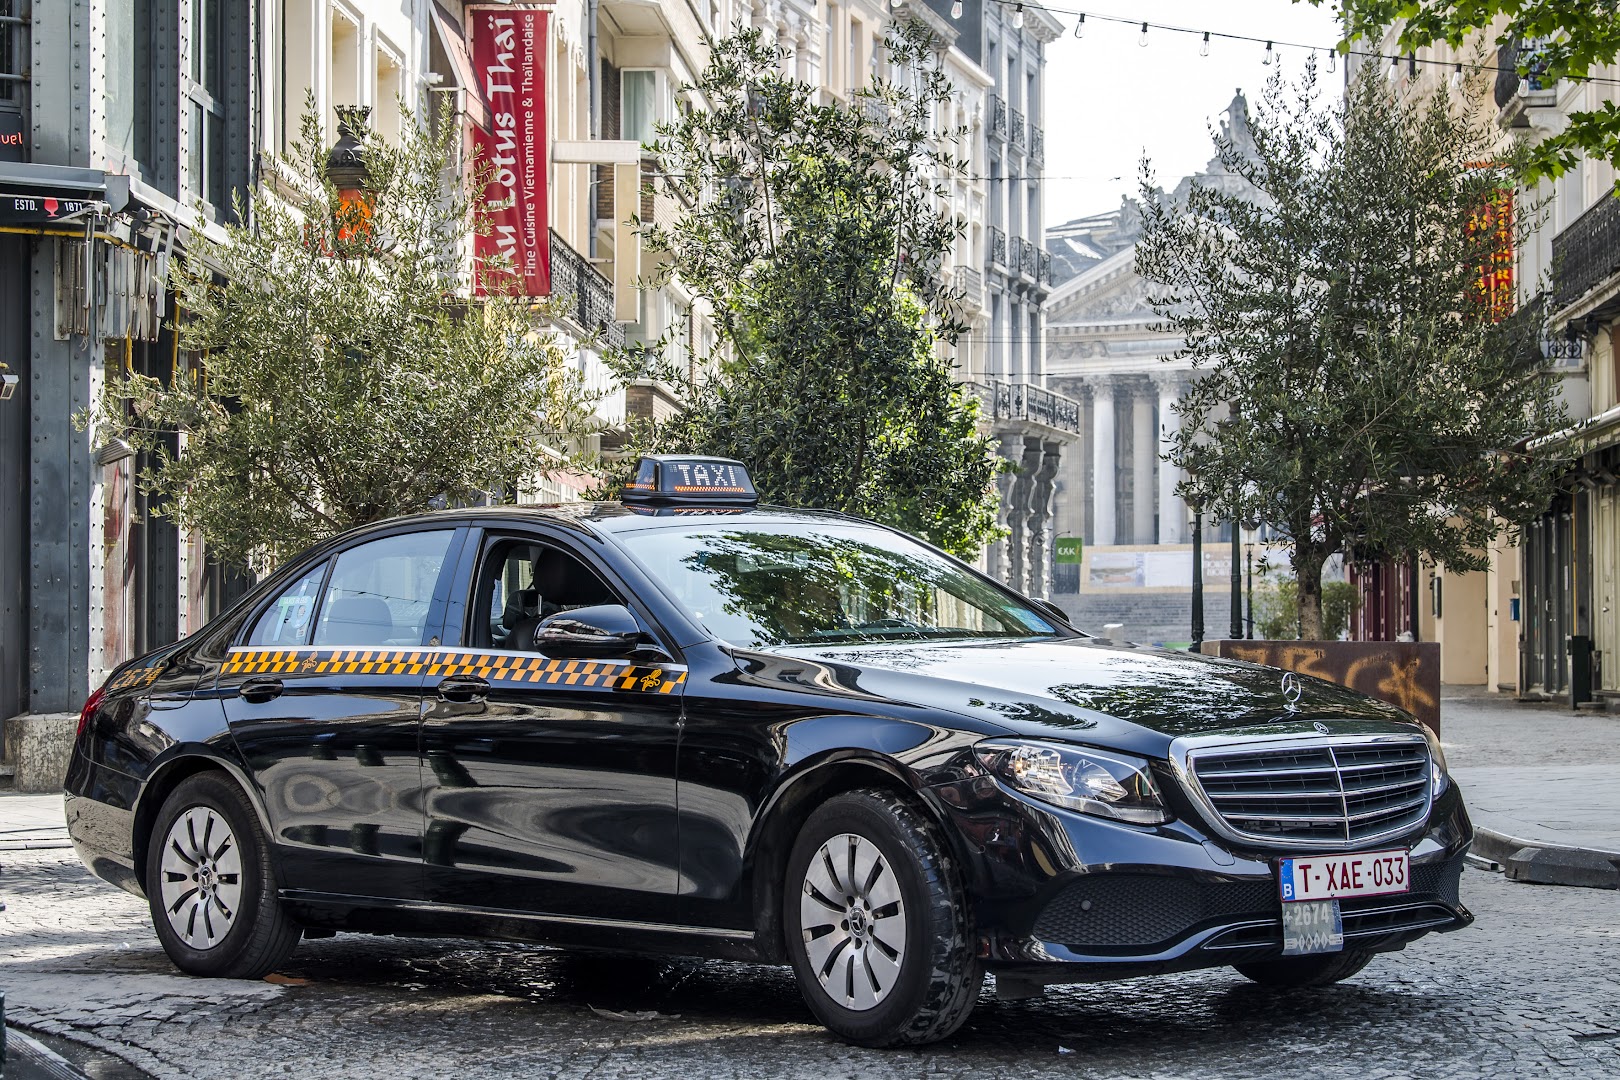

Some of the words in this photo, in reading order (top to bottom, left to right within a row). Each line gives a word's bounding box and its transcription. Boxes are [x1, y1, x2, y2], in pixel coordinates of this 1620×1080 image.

[486, 14, 515, 103] Thaï
[521, 14, 534, 95] Thaïlandaise
[521, 97, 534, 108] &
[487, 112, 516, 208] Lotus
[523, 110, 535, 200] Vietnamienne
[14, 199, 38, 211] ESTD.
[64, 202, 83, 212] 1871
[523, 202, 536, 247] Cuisine
[524, 250, 536, 277] Fine
[677, 464, 737, 487] TAXI
[110, 666, 164, 689] 2674
[1298, 856, 1405, 893] T-XAE-033
[1283, 883, 1293, 898] B
[1293, 902, 1330, 927] 2674
